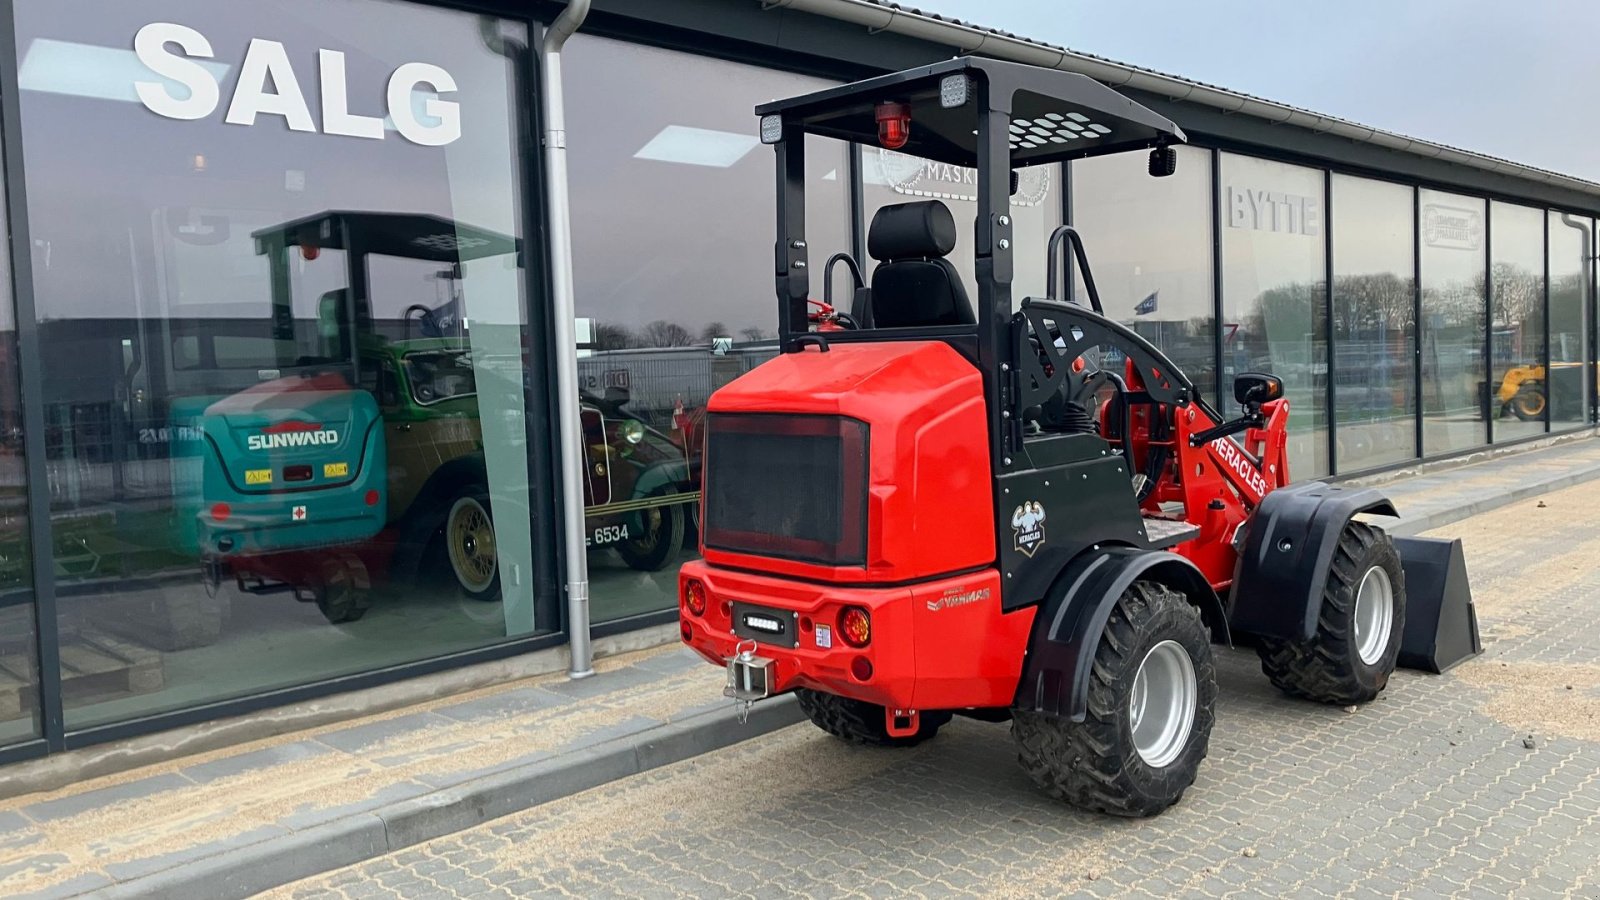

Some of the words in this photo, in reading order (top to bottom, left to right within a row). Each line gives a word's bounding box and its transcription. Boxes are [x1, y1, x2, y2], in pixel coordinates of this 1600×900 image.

[134, 22, 461, 146] SALG
[1228, 187, 1317, 236] BYTTE
[247, 430, 338, 450] SUNWARD
[1211, 437, 1266, 497] HERACLES
[594, 524, 629, 544] 6534
[1019, 531, 1040, 544] HERACLES
